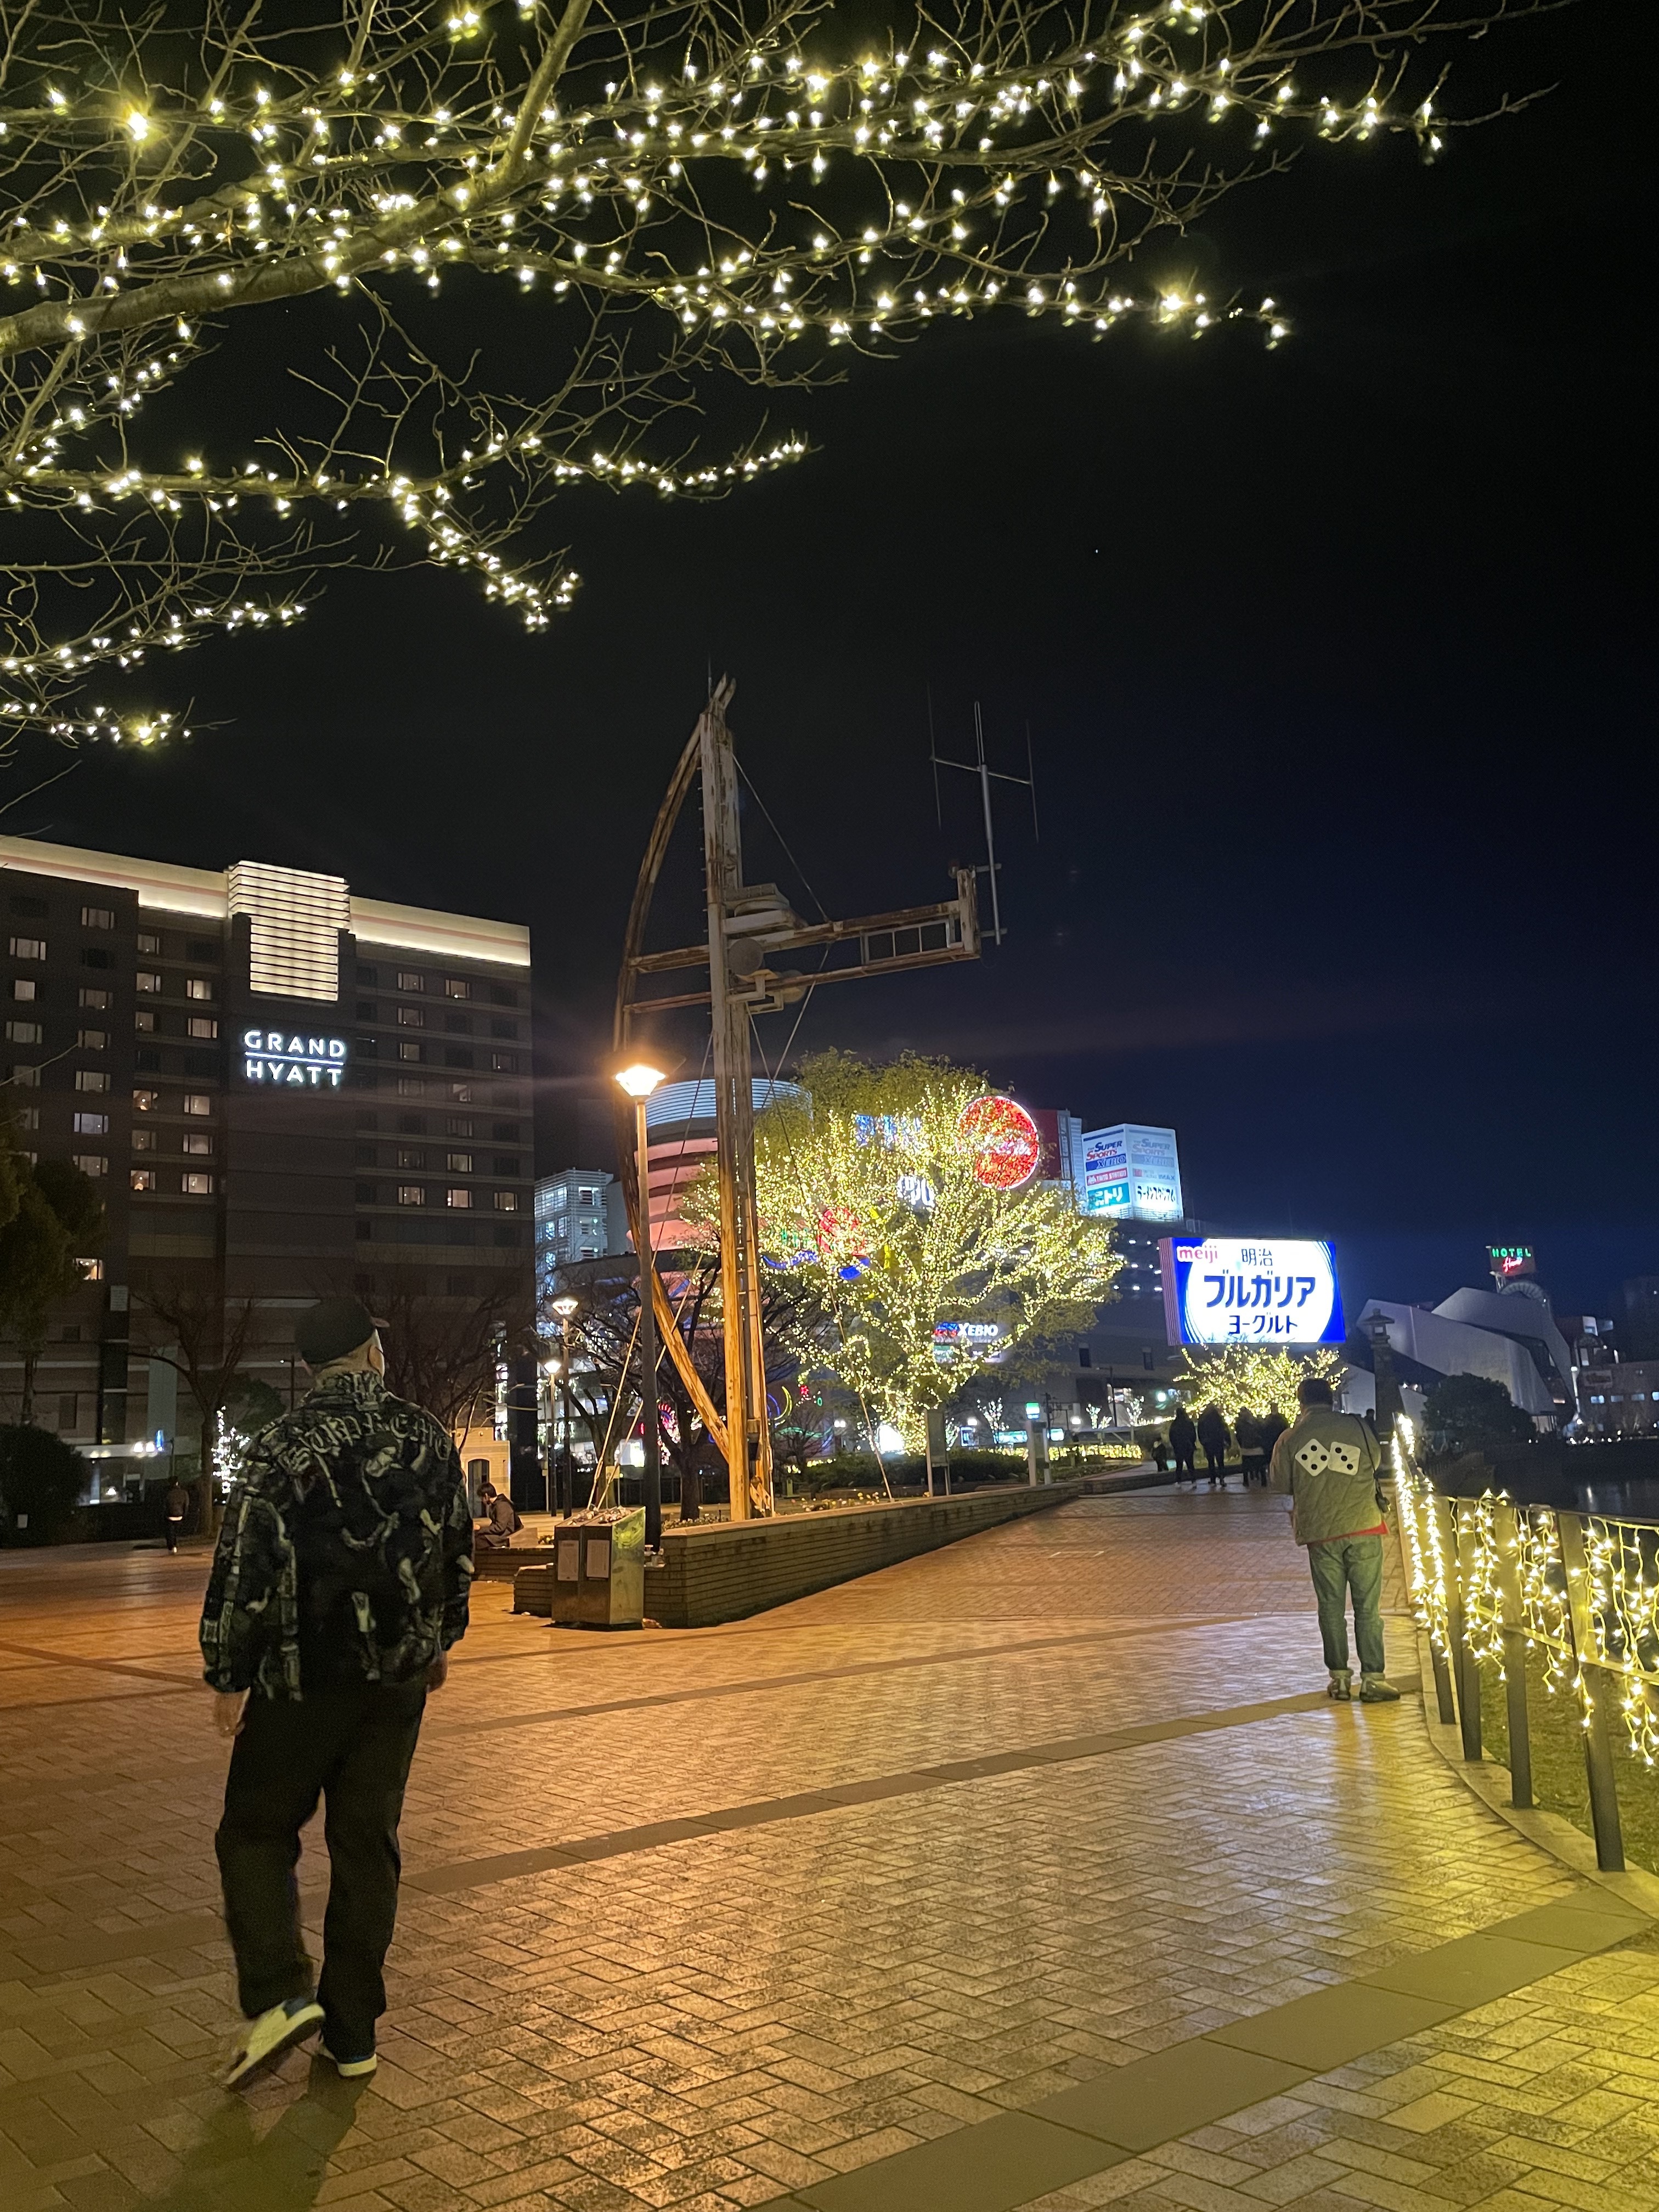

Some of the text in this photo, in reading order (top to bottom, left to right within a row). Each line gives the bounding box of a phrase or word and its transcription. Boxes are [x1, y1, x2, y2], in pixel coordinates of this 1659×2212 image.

[244, 1030, 345, 1058] GRAND
[246, 1059, 343, 1086] HYATT
[1095, 1187, 1123, 1206] ニトリ
[1180, 1245, 1218, 1263] meiji
[1241, 1249, 1273, 1266] 明治
[1492, 1248, 1531, 1257] HOTEL
[1204, 1269, 1316, 1308] ブルガリア
[957, 1323, 998, 1336] XEBIO
[1228, 1312, 1298, 1334] ヨーグルト
